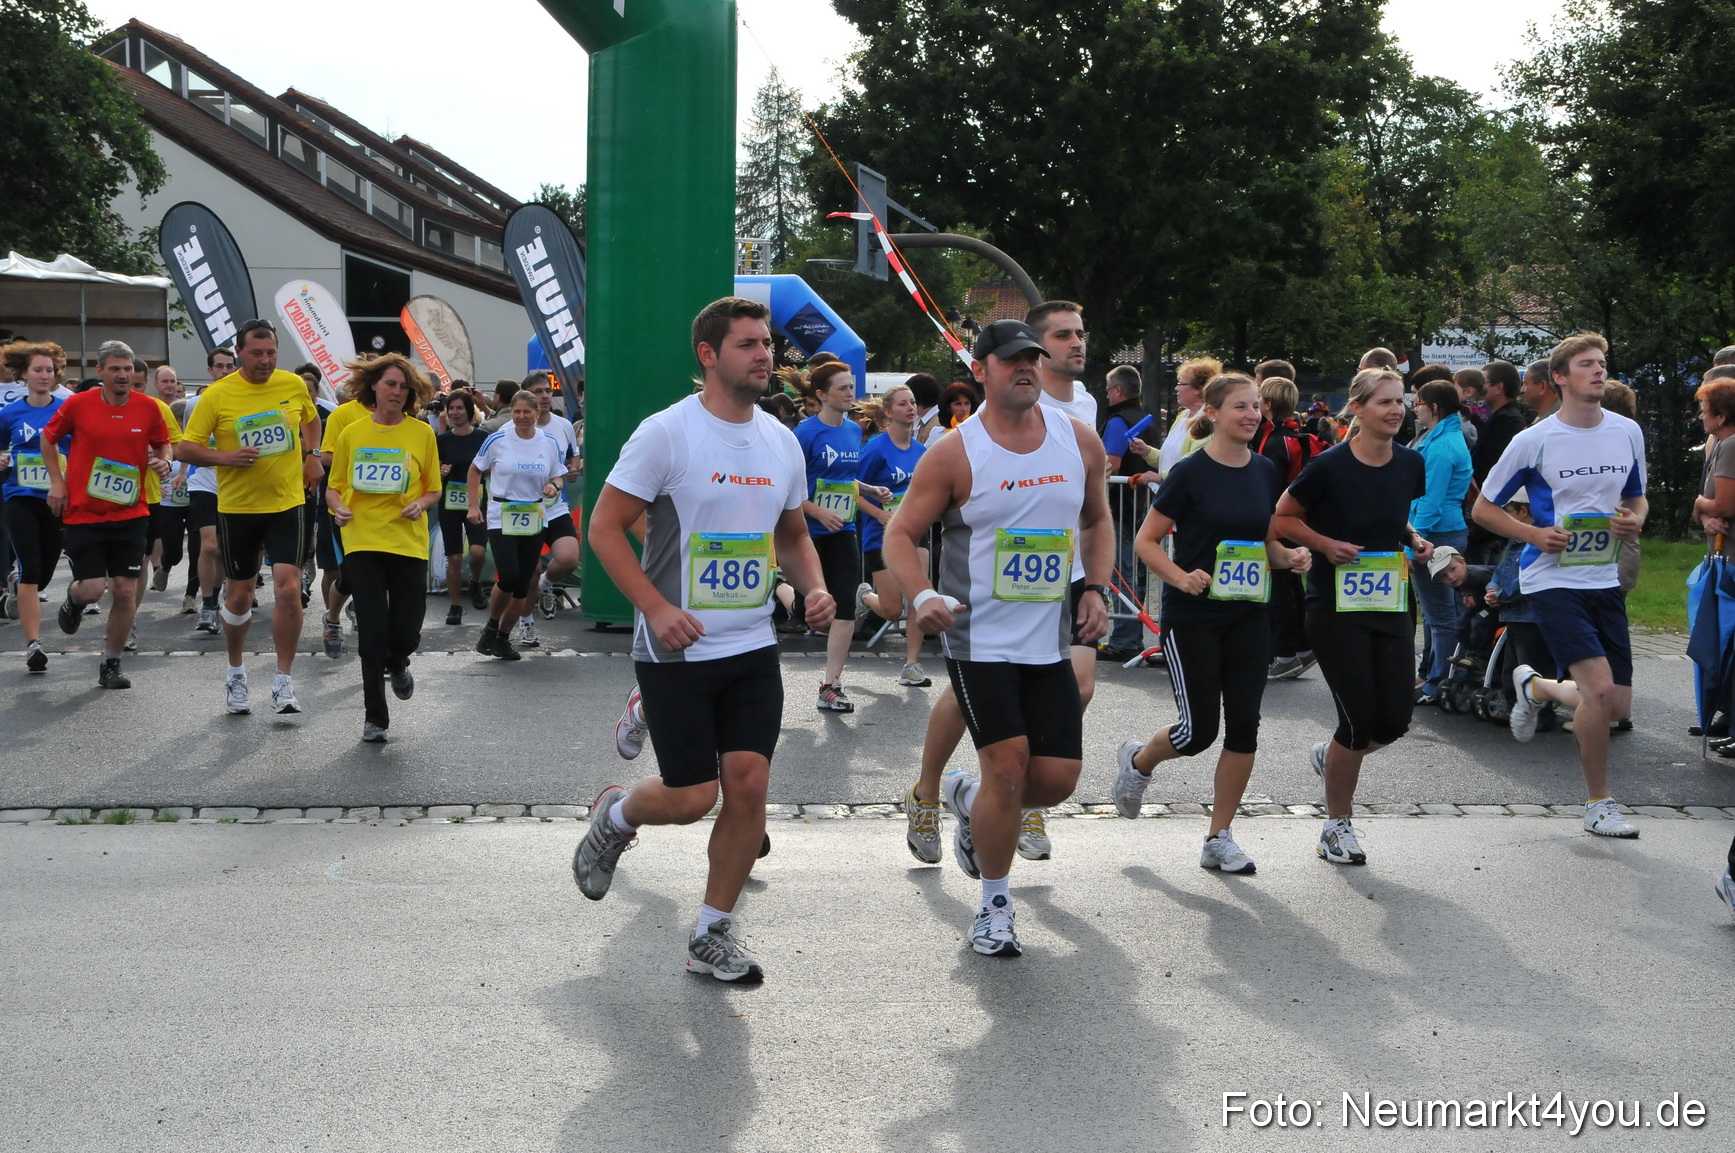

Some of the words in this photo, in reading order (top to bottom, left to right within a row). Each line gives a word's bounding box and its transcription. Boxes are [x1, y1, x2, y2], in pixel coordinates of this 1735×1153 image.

[241, 426, 286, 447] 1289
[20, 466, 49, 480] 117
[355, 464, 402, 482] 1278
[517, 462, 545, 471] heinloth
[1559, 465, 1628, 479] DELPHI
[93, 472, 133, 495] 1150
[729, 475, 775, 487] KLEBL
[1018, 474, 1068, 488] KLEBL
[449, 491, 467, 504] 55
[816, 494, 851, 511] 1171
[511, 513, 530, 527] 75
[1565, 530, 1610, 552] 929
[699, 560, 760, 590] 486
[1003, 553, 1061, 583] 498
[1218, 561, 1260, 587] 546
[1011, 583, 1031, 591] Peter
[1343, 572, 1392, 596] 554
[712, 591, 739, 599] Markus
